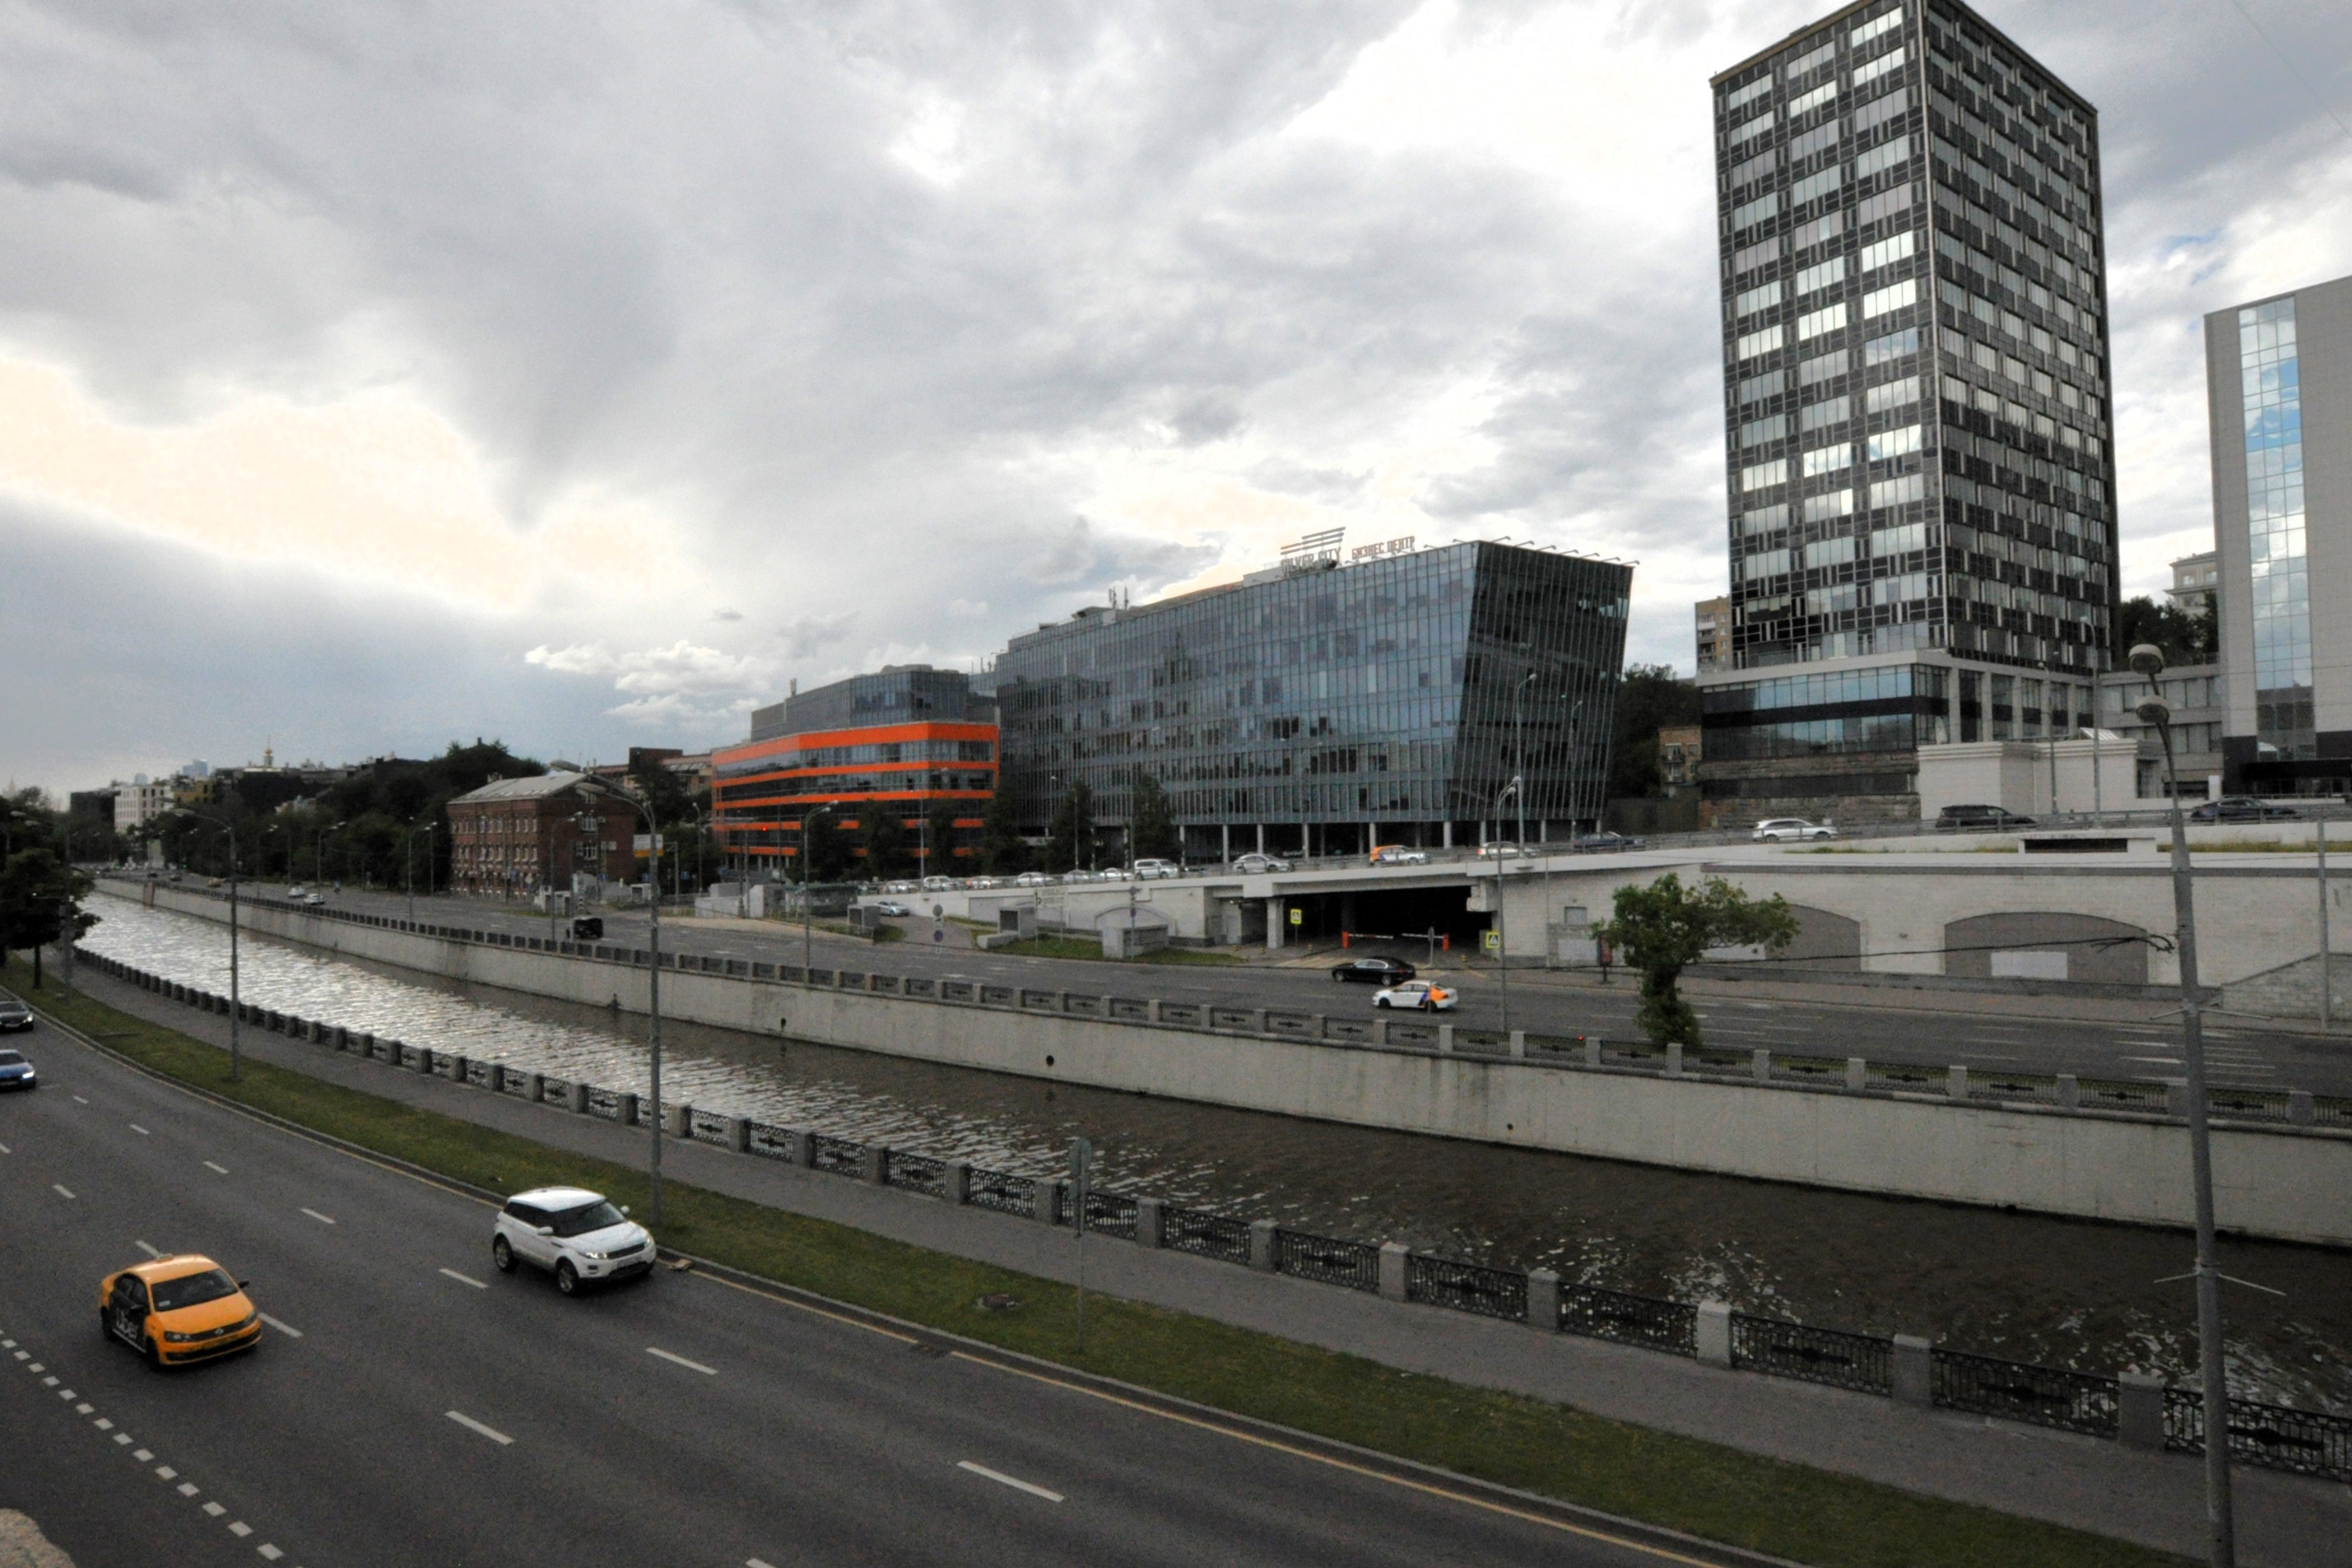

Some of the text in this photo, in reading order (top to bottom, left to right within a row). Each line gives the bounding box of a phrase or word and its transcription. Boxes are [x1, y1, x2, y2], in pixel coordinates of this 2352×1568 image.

[1318, 547, 1341, 569] CITY
[1352, 535, 1415, 560] БИЗНЕС ЦЕНТР
